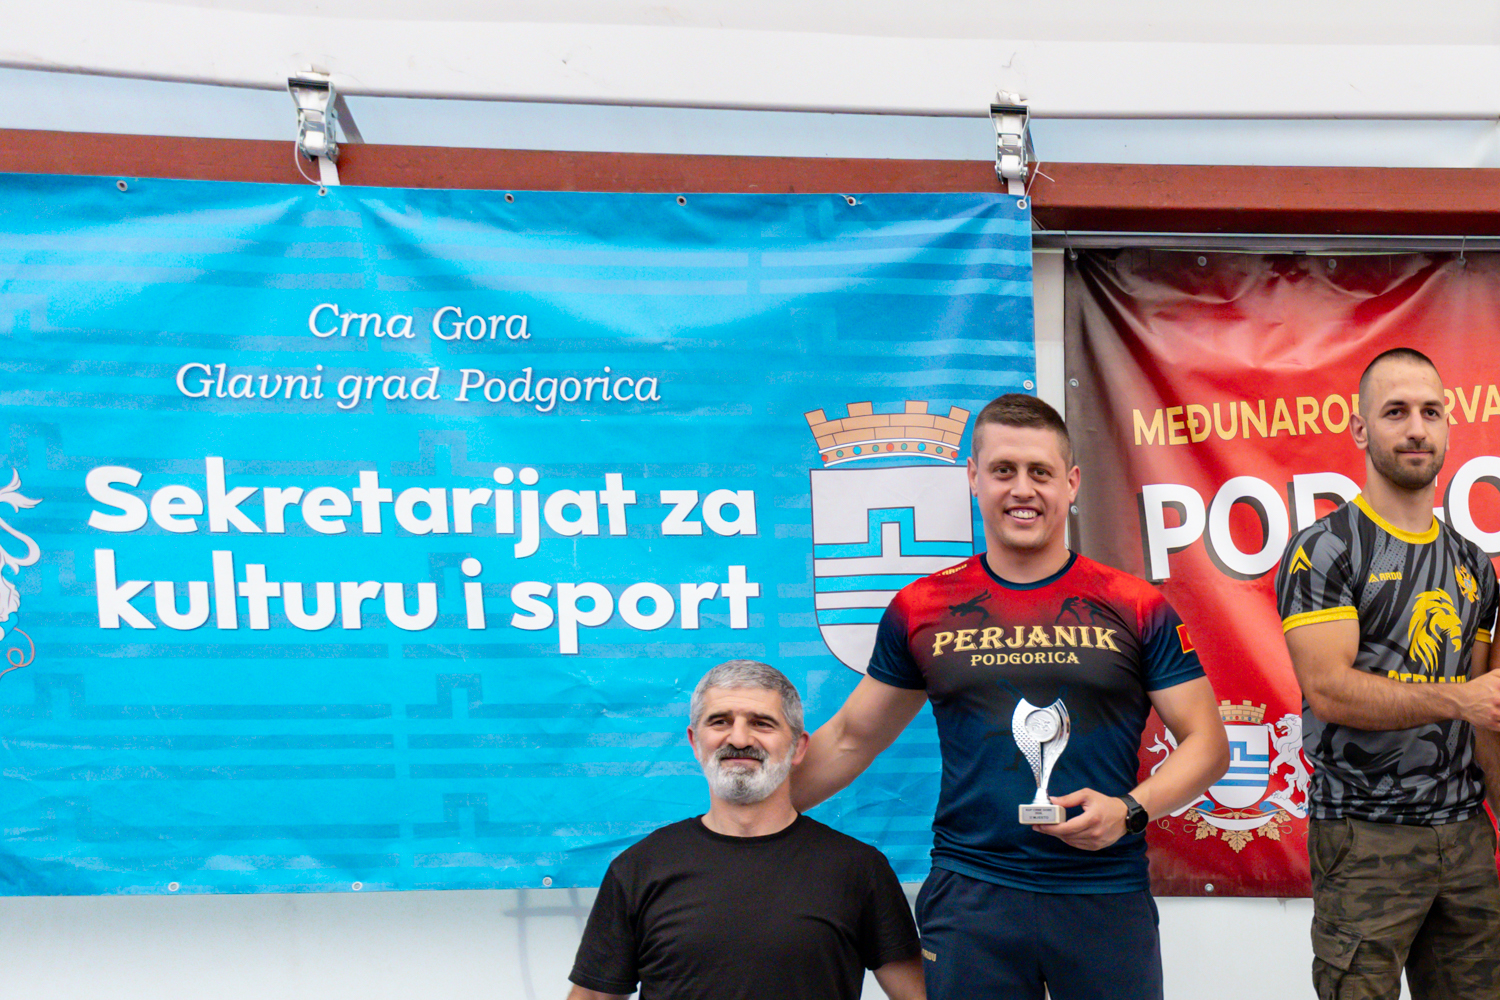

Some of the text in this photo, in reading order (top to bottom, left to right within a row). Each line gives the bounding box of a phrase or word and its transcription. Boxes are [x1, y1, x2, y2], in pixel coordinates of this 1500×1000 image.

[308, 303, 532, 341] Crna Gora
[176, 362, 661, 412] Glavni grad Podgorica
[1132, 393, 1360, 446] MEĐUNARO
[85, 456, 758, 559] Sekretarijat za
[95, 549, 760, 655] kulturu i sport
[932, 625, 1122, 657] PERJANIK
[970, 651, 1081, 667] PODGORICA
